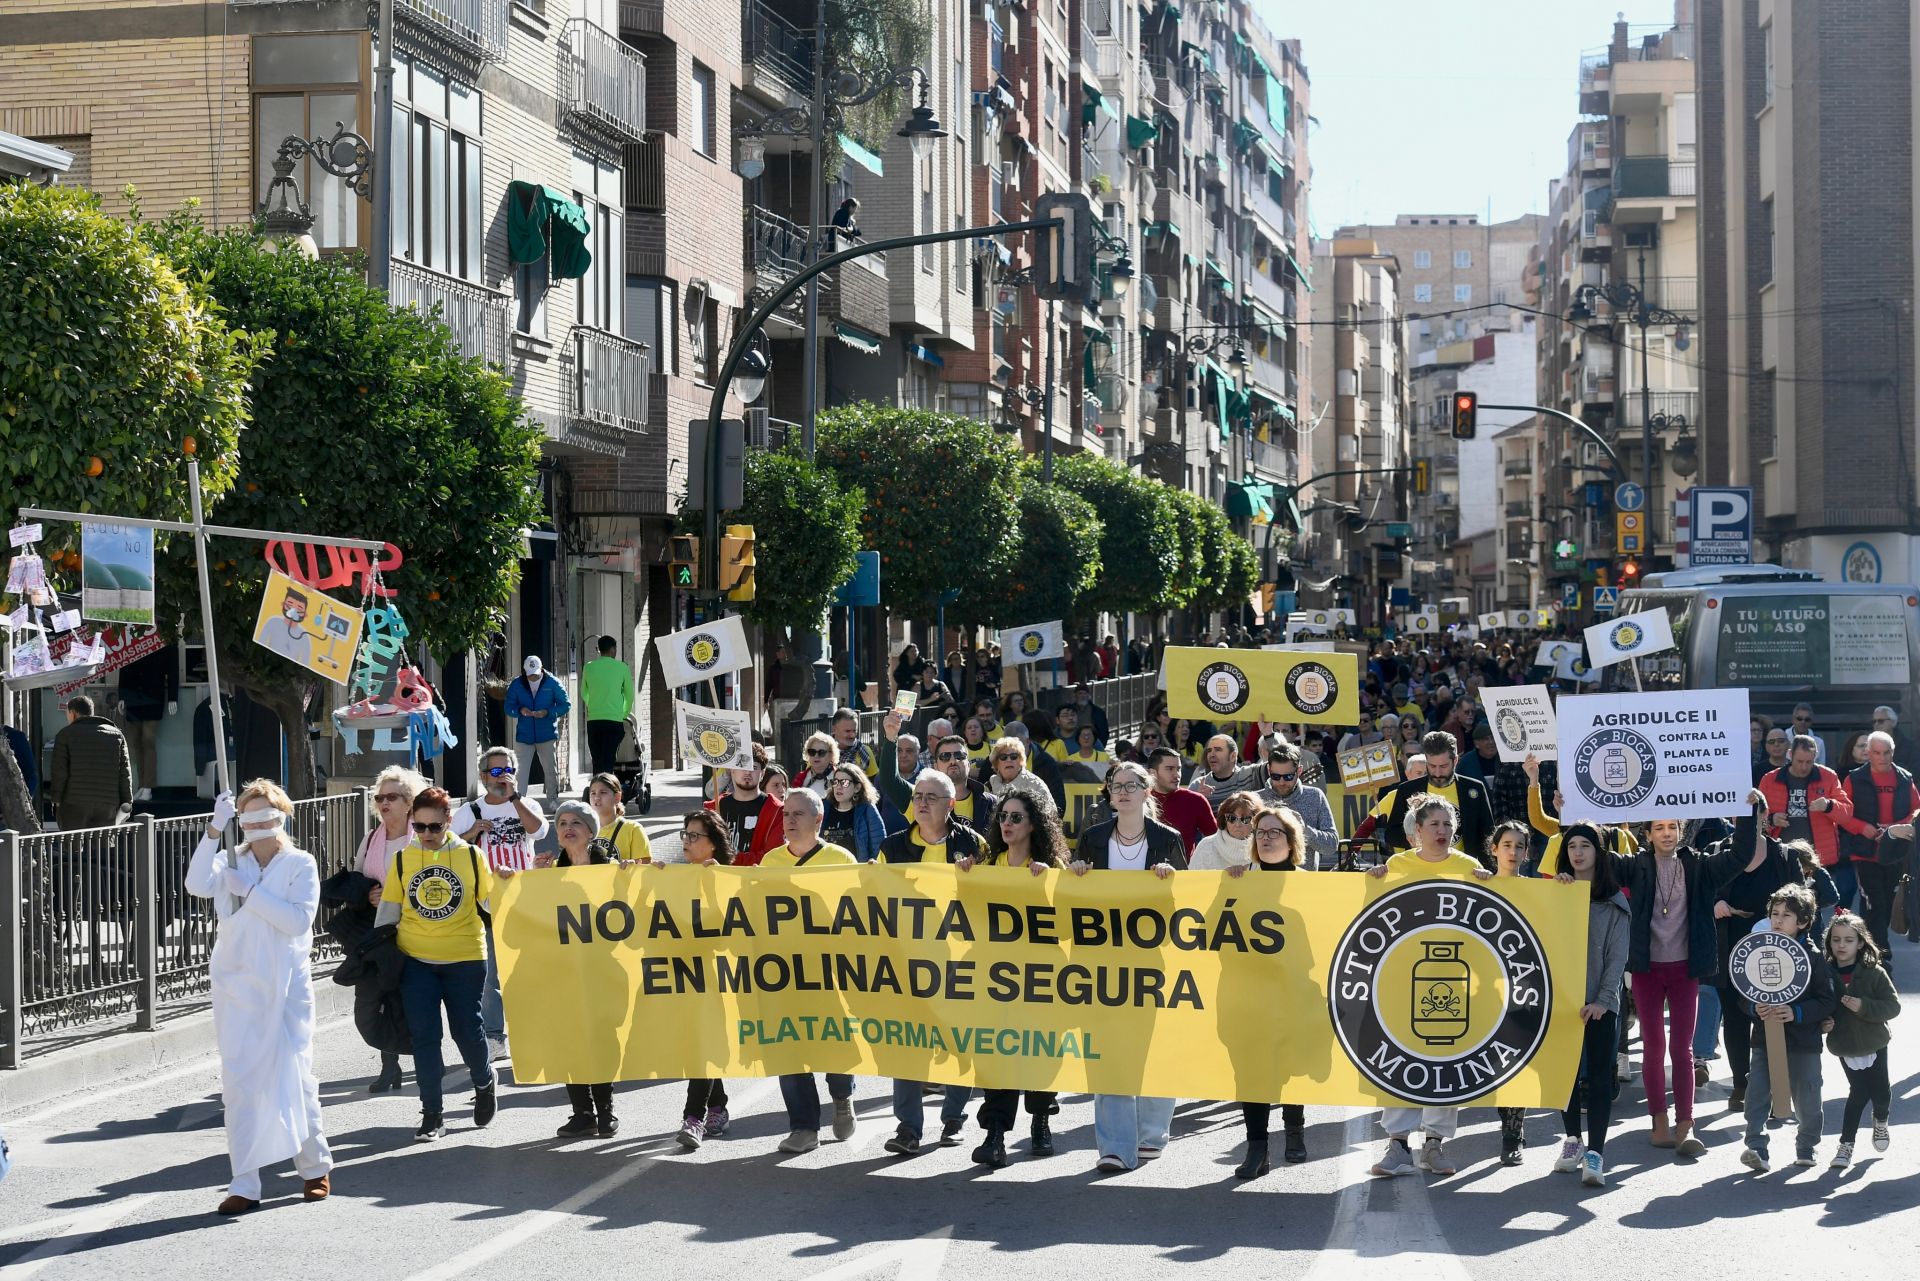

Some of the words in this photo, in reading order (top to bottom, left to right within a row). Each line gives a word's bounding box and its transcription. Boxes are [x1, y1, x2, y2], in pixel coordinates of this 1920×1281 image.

[1697, 492, 1748, 539] P
[1737, 610, 1758, 621] TU
[1722, 623, 1732, 634] A
[1737, 623, 1758, 634] UN
[1199, 667, 1214, 687] STOP
[1287, 666, 1303, 685] STOP
[1207, 699, 1240, 712] MOLINA
[1295, 699, 1328, 712] MOLINA
[1496, 697, 1533, 707] AGRIDULCE
[1592, 710, 1699, 727] AGRIDULCE
[1705, 709, 1717, 722] II
[1658, 732, 1707, 743] CONTRA
[1711, 730, 1726, 740] LA
[1577, 736, 1599, 774] STOP
[1664, 749, 1711, 759] PLANTA
[1714, 747, 1730, 756] DE
[1668, 763, 1713, 774] BIOGAS
[1588, 784, 1649, 806] MOLINA
[1654, 790, 1696, 807] AQUÍ
[1702, 791, 1737, 804] NO!!
[409, 873, 426, 897] STOP
[416, 905, 455, 918] MOLINA
[558, 900, 635, 945] NO
[648, 900, 682, 939] A
[692, 896, 755, 939] LA
[766, 895, 977, 943] PLANTA
[988, 902, 1059, 946] DE
[1071, 898, 1285, 955] BIOGÁS
[1341, 907, 1403, 1001] STOP
[1733, 941, 1753, 974] STOP
[642, 956, 706, 996] EN
[717, 953, 903, 995] MOLINA
[909, 958, 976, 999] DE
[987, 961, 1204, 1010] SEGURA
[1745, 984, 1803, 1003] MOLINA
[738, 1016, 948, 1052] PLATAFORMA
[951, 1027, 1101, 1060] VECINAL
[1366, 1040, 1522, 1093] MOLINA
